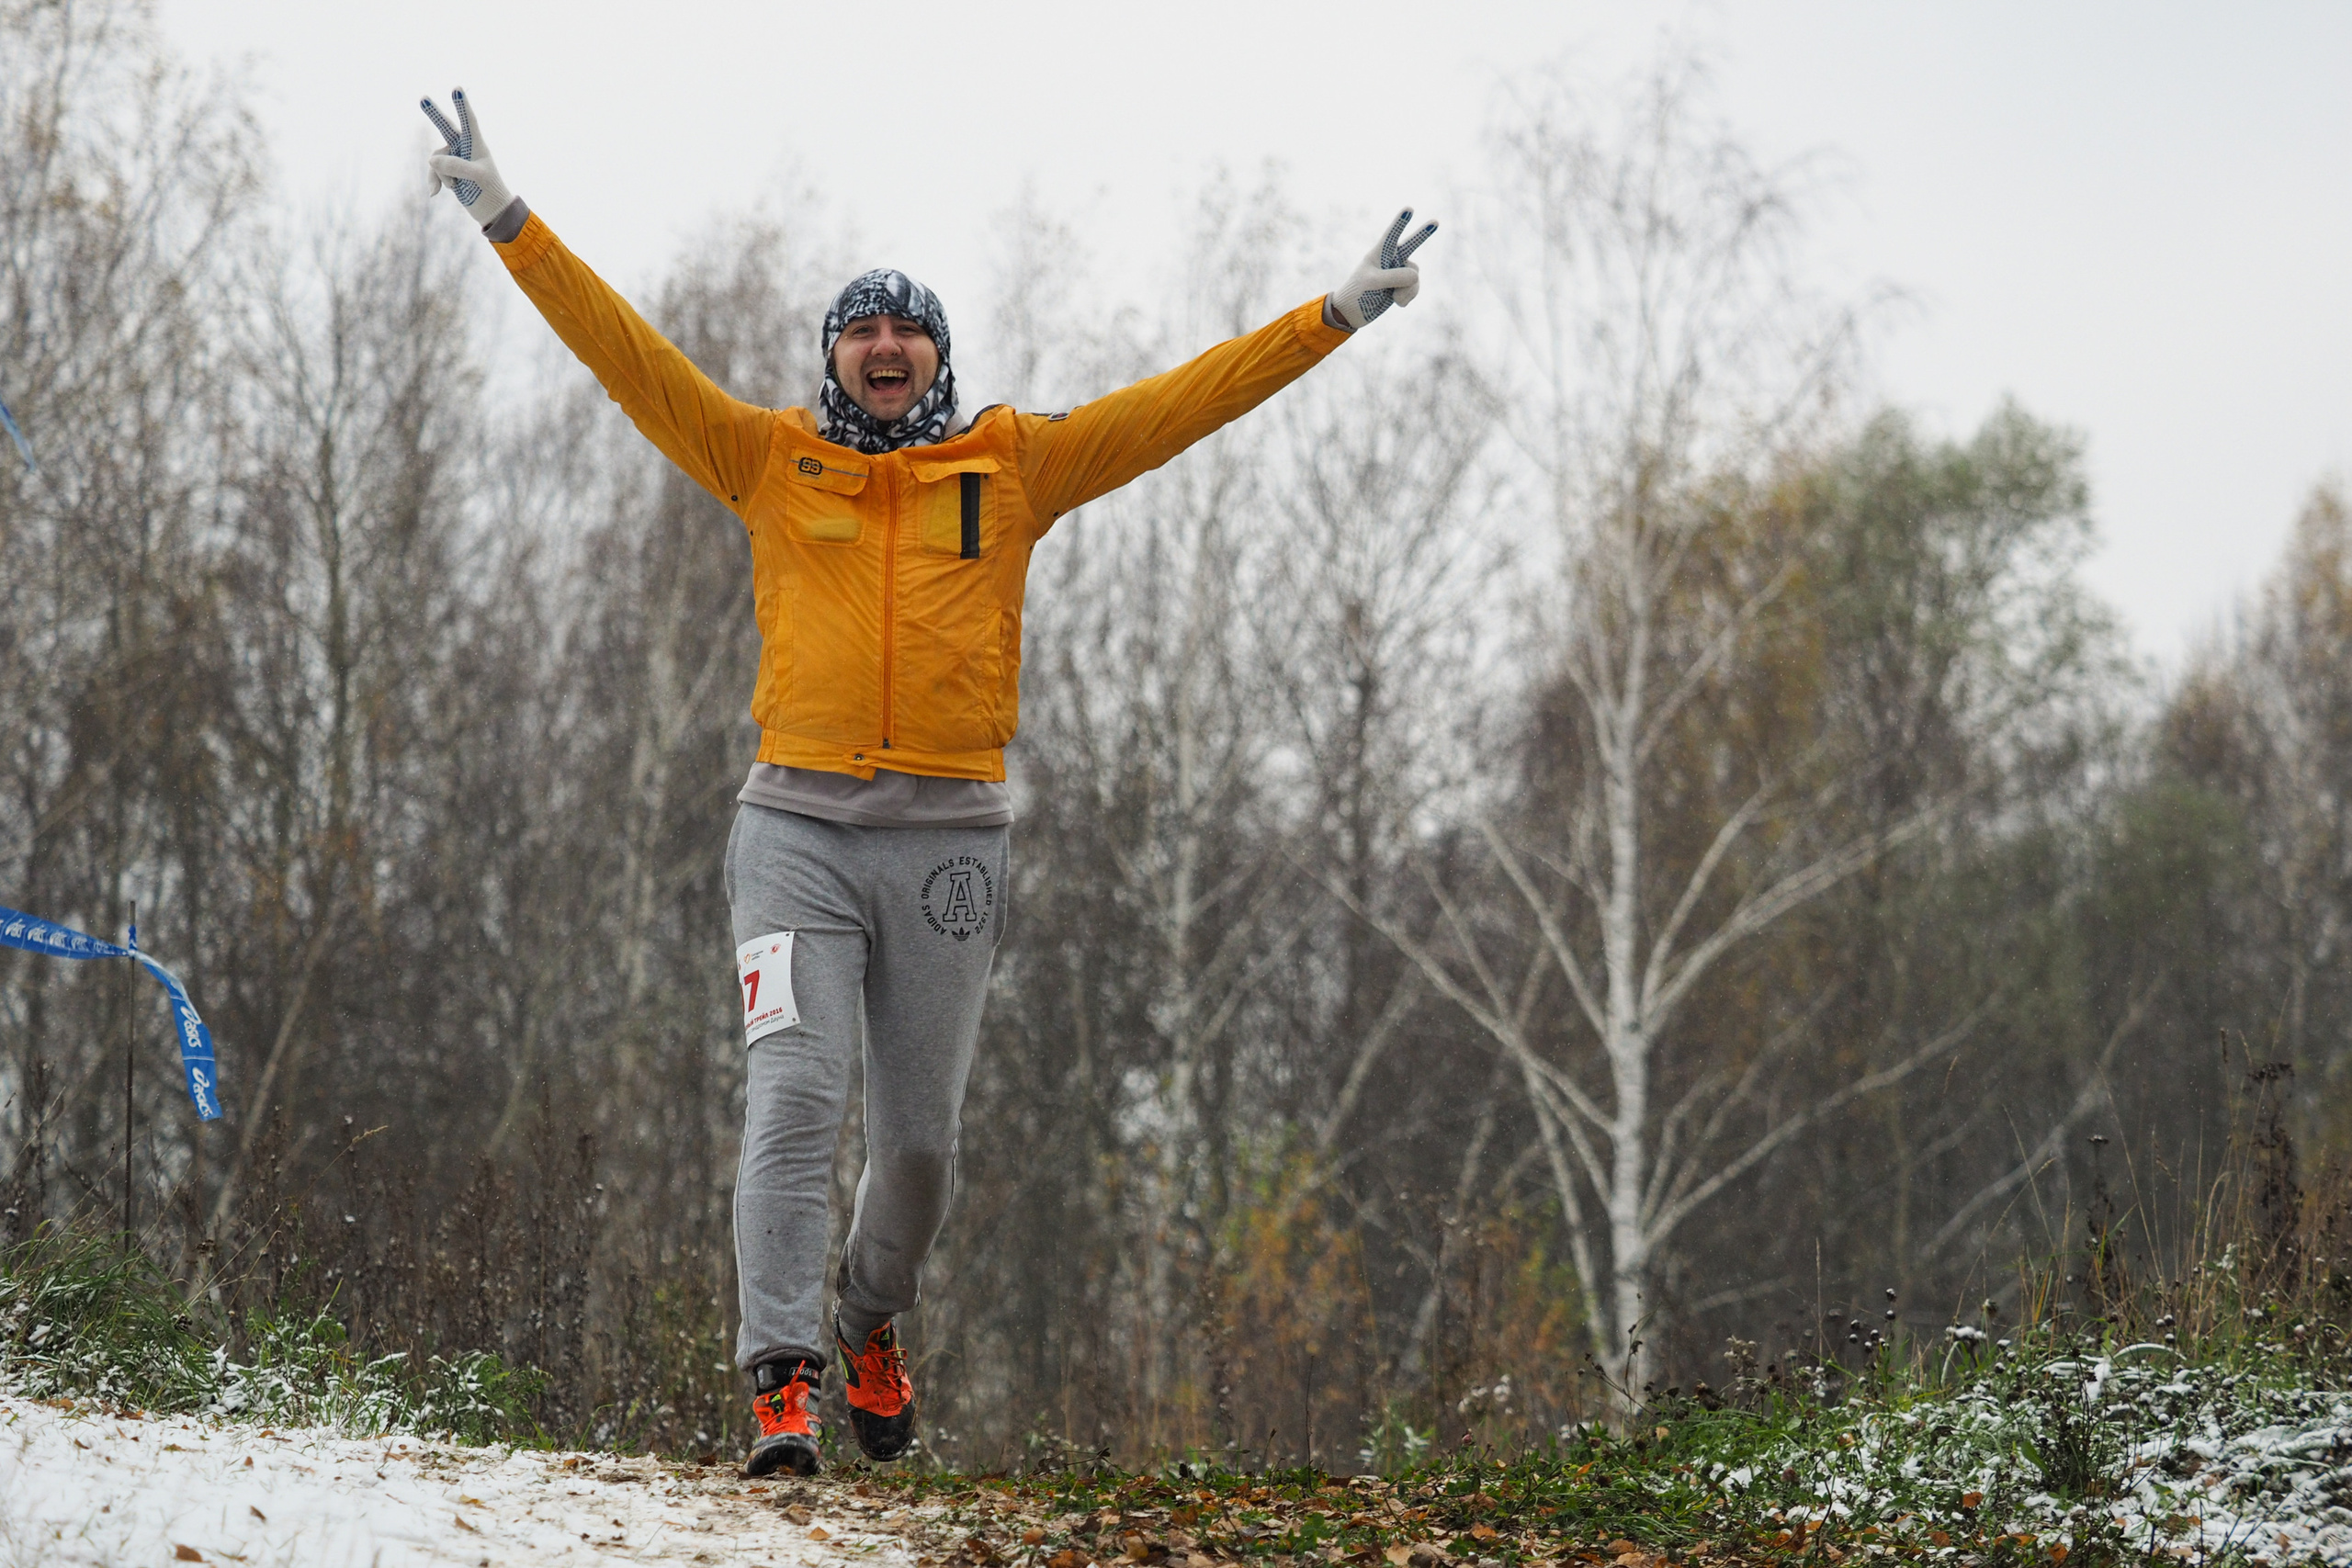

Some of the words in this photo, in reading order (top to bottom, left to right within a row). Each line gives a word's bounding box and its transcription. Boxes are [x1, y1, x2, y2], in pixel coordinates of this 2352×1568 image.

[922, 859, 955, 899] ORIGINALS
[943, 871, 977, 922] A
[959, 856, 992, 906] ESTABLISHED
[922, 905, 947, 935] ADIDAS
[975, 911, 988, 934] 1972
[741, 969, 760, 1015] 7
[792, 1368, 812, 1376] spot
